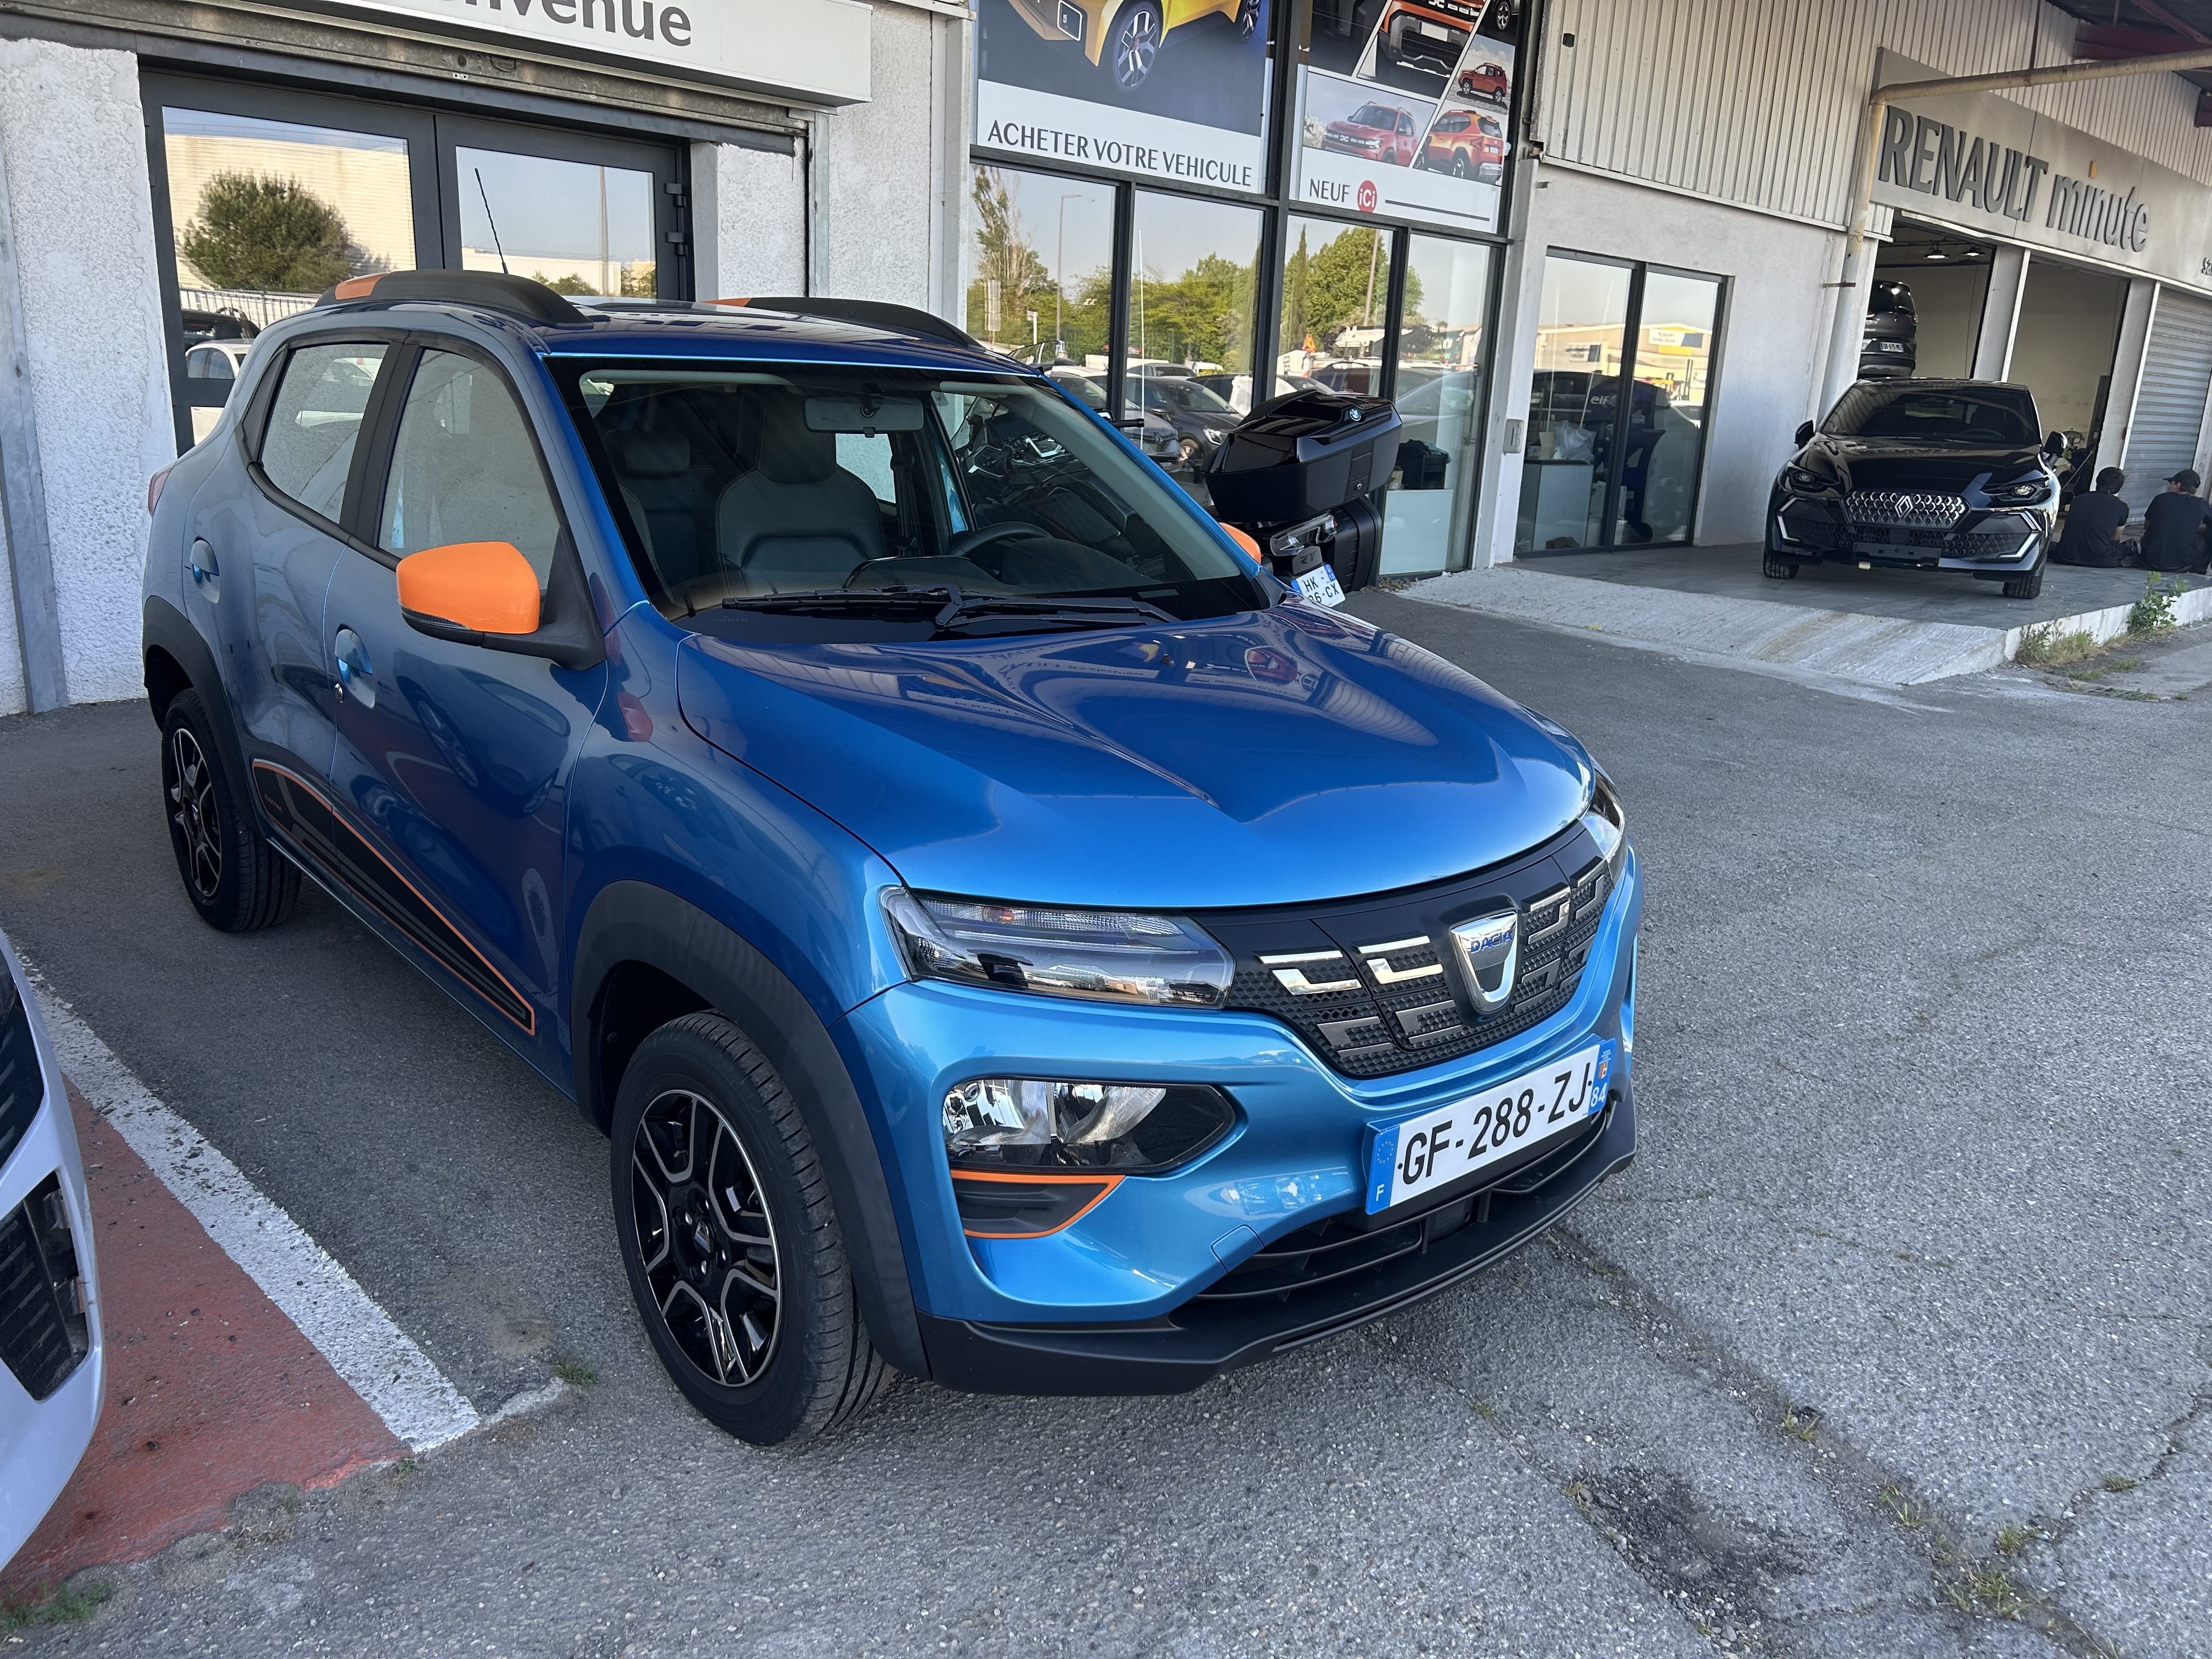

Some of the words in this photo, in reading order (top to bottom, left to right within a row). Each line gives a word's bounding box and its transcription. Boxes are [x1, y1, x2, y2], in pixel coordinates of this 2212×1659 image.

[988, 120, 1090, 159] ACHETER
[1093, 138, 1159, 171] VOTRE
[1162, 151, 1252, 187] VEHICULE
[1878, 105, 2049, 222] RENAULT
[2046, 160, 2151, 252] minute
[1309, 178, 1351, 202] NEUF
[1470, 929, 1513, 954] DACIA
[1376, 1183, 1385, 1201] F
[1402, 1062, 1591, 1185] GF-288-ZJ
[1590, 1082, 1607, 1108] 84
